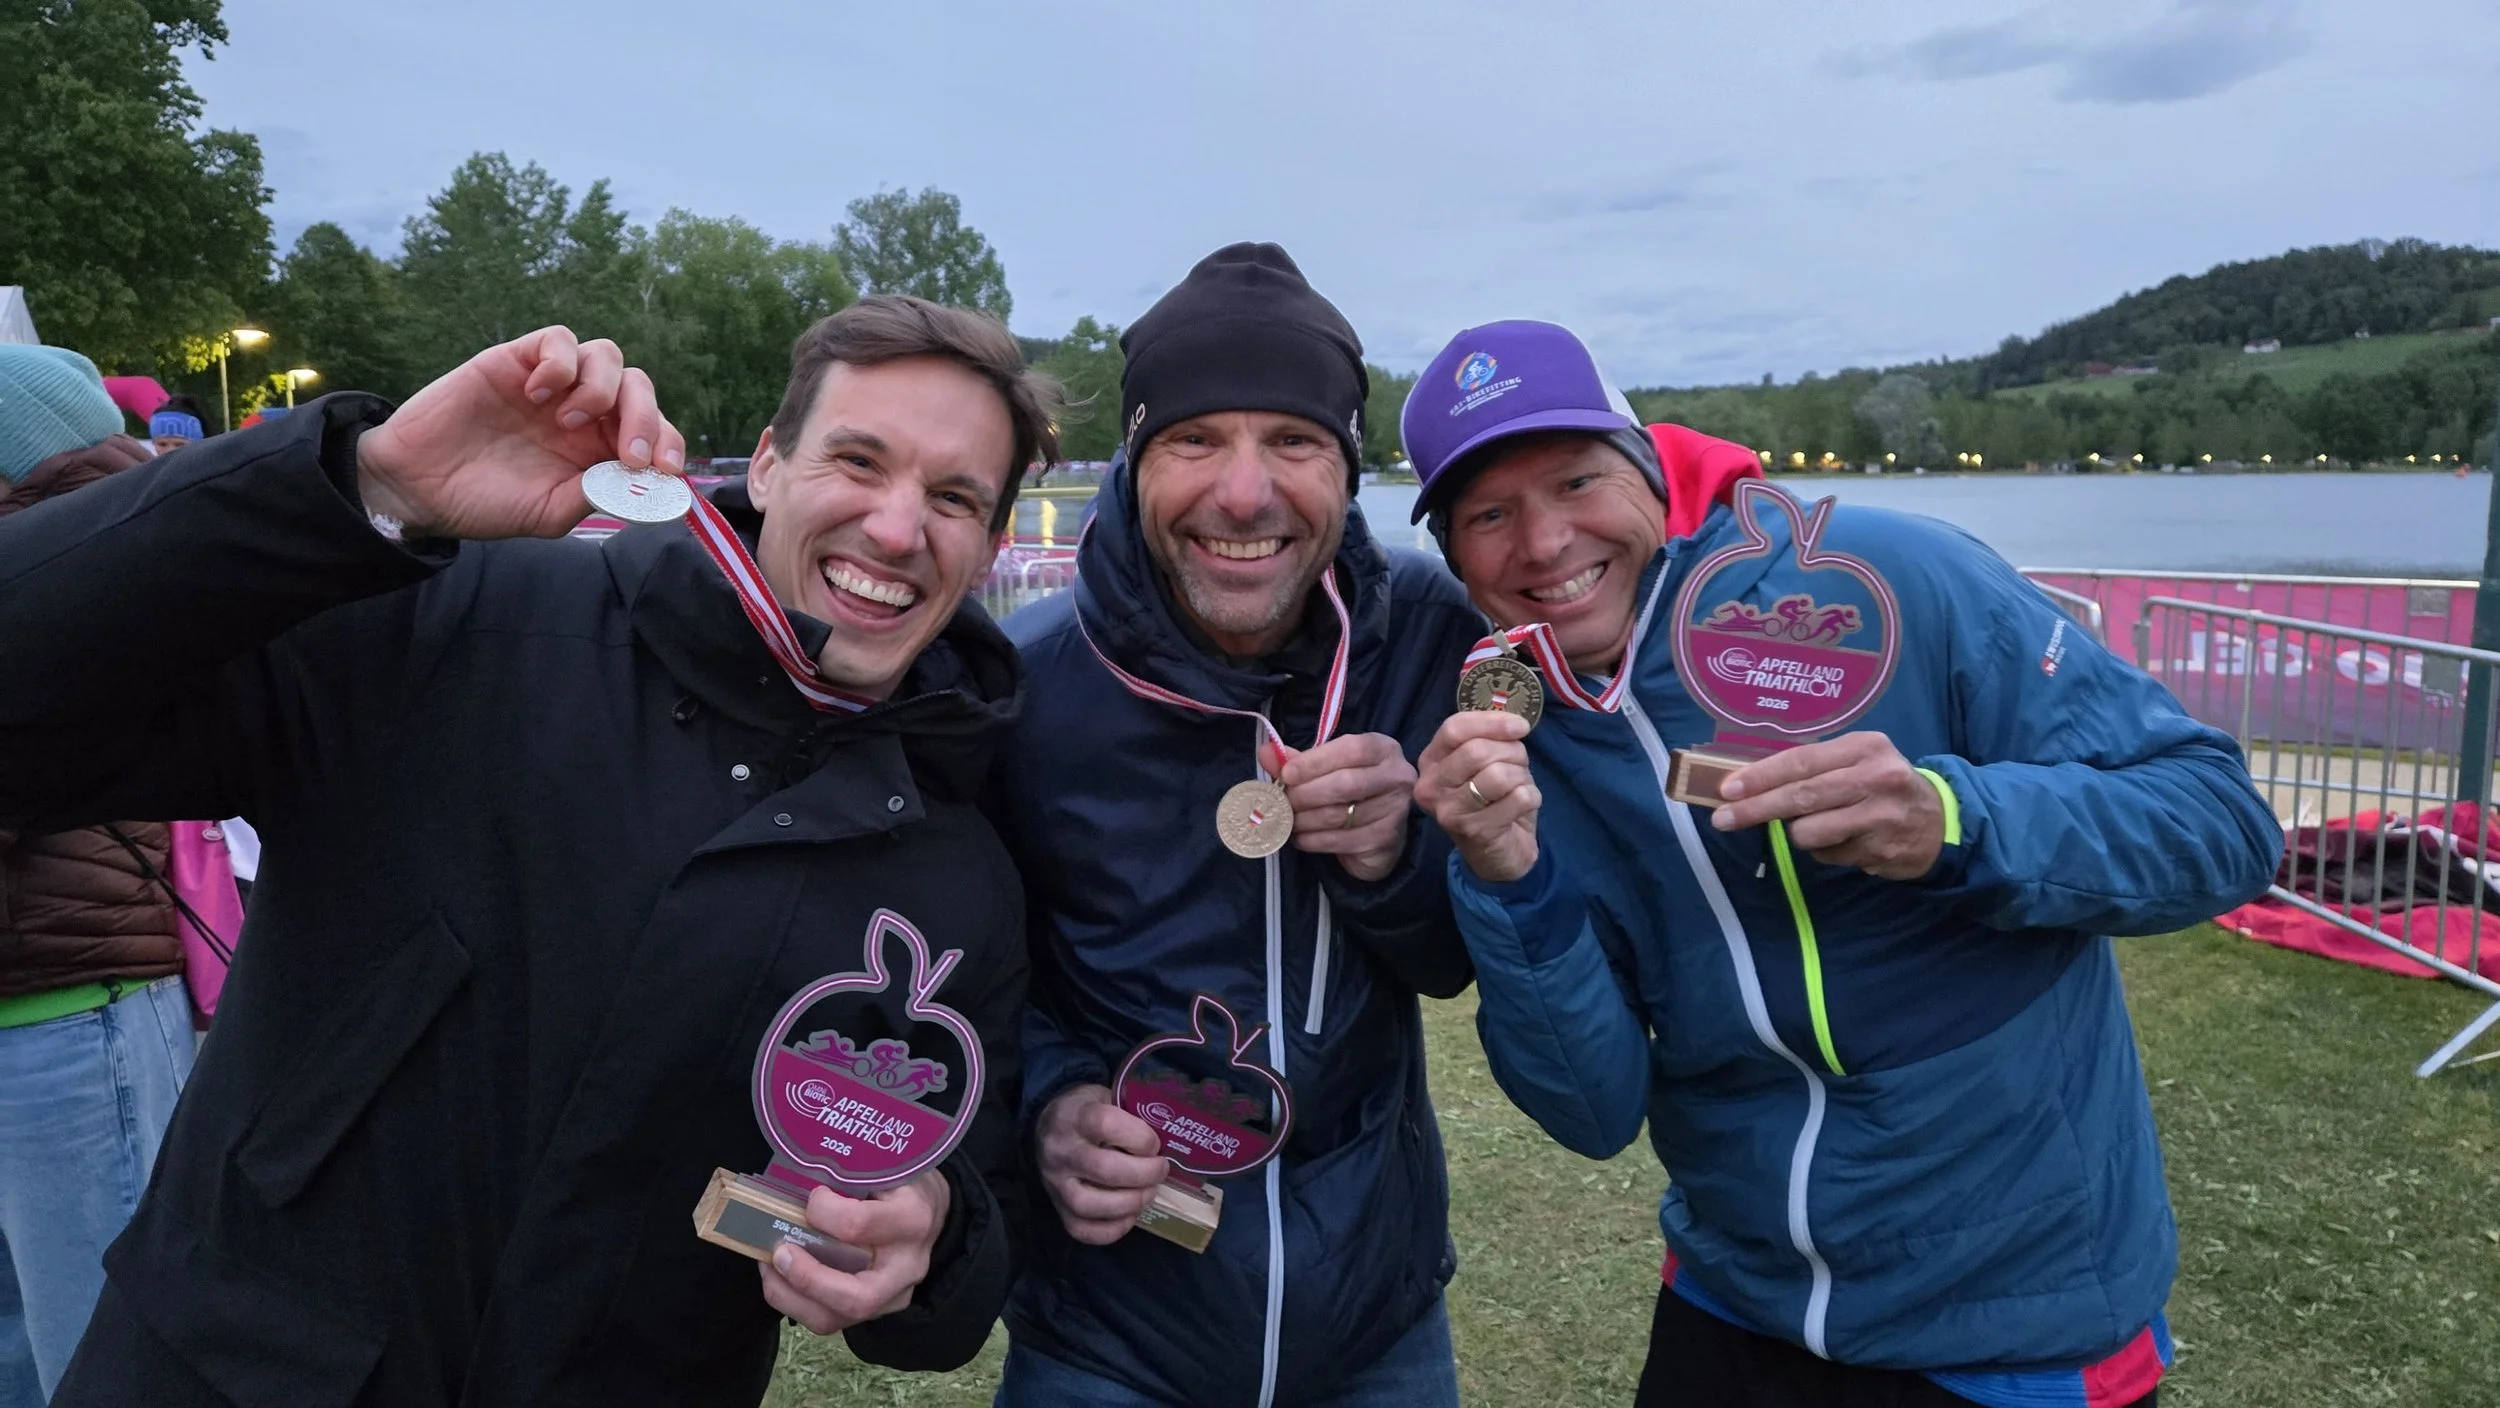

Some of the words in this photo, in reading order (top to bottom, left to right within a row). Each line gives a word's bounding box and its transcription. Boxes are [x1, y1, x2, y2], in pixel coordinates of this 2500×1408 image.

[1743, 669, 1843, 699] TRIATHLON
[1757, 656, 1845, 682] APFELLAND
[1756, 696, 1790, 710] 2026
[815, 1106, 909, 1155] TRIATHLON
[833, 1096, 915, 1138] APFELLAND
[1174, 1116, 1241, 1149] APFELLAND
[820, 1136, 853, 1156] 2026
[1161, 1120, 1237, 1159] TRIATHLON
